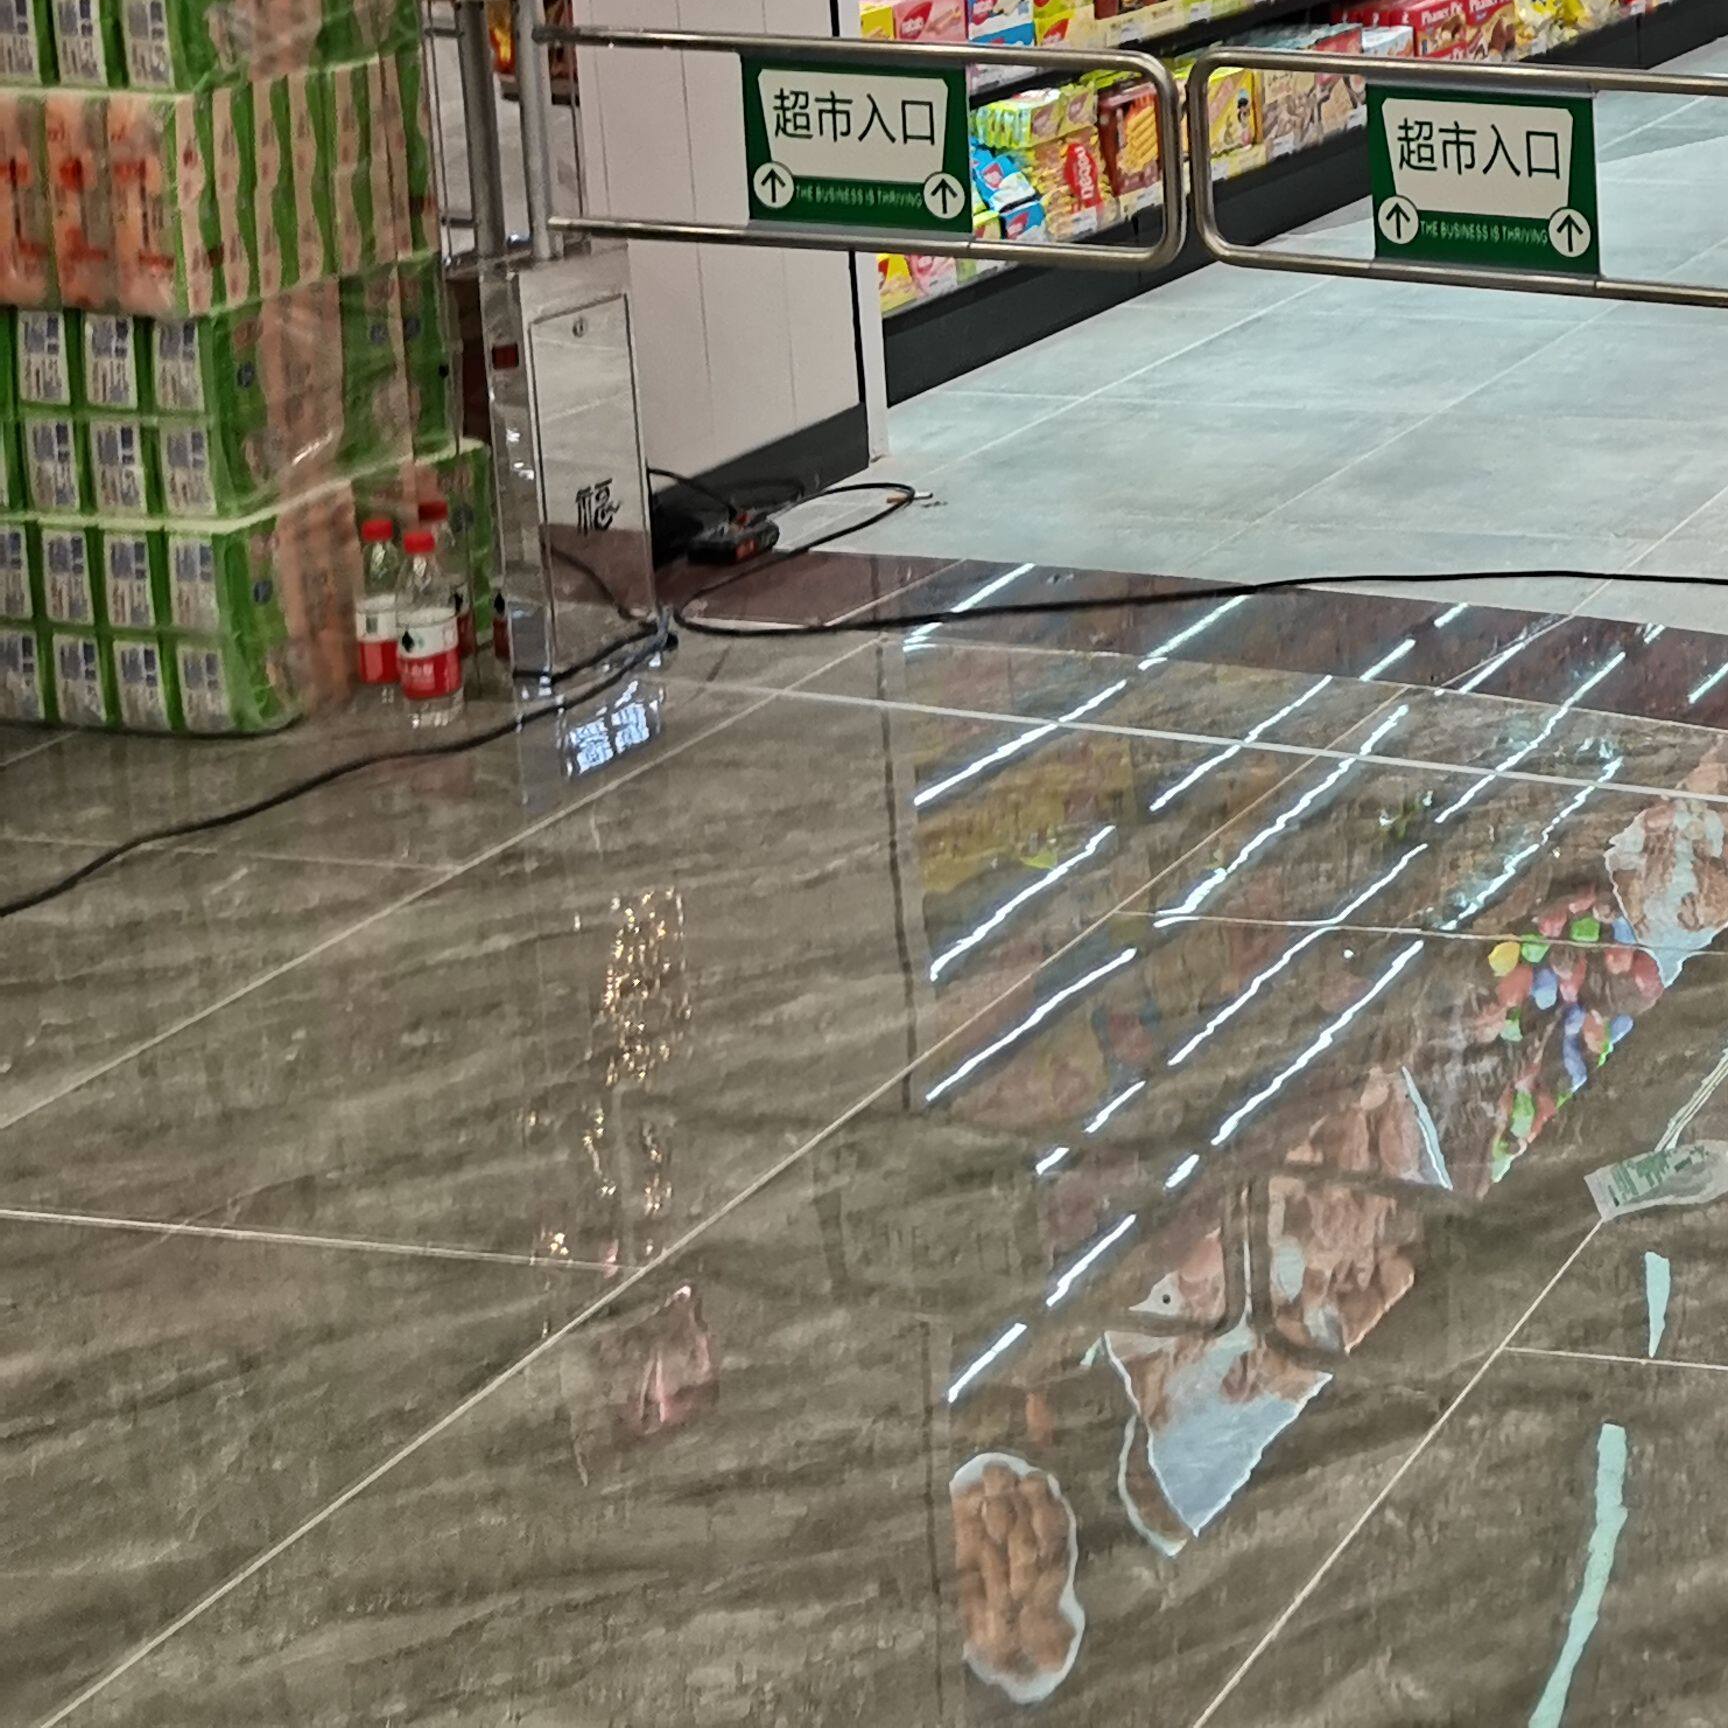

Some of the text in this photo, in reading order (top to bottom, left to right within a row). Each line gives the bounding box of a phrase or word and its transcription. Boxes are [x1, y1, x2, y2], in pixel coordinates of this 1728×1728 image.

[773, 88, 936, 146] 超市入口
[1397, 117, 1561, 180] 超市入口
[795, 185, 923, 209] THE BUSINESS IS THRIVING
[1420, 221, 1549, 245] THE BUSINESS IS THRIVING
